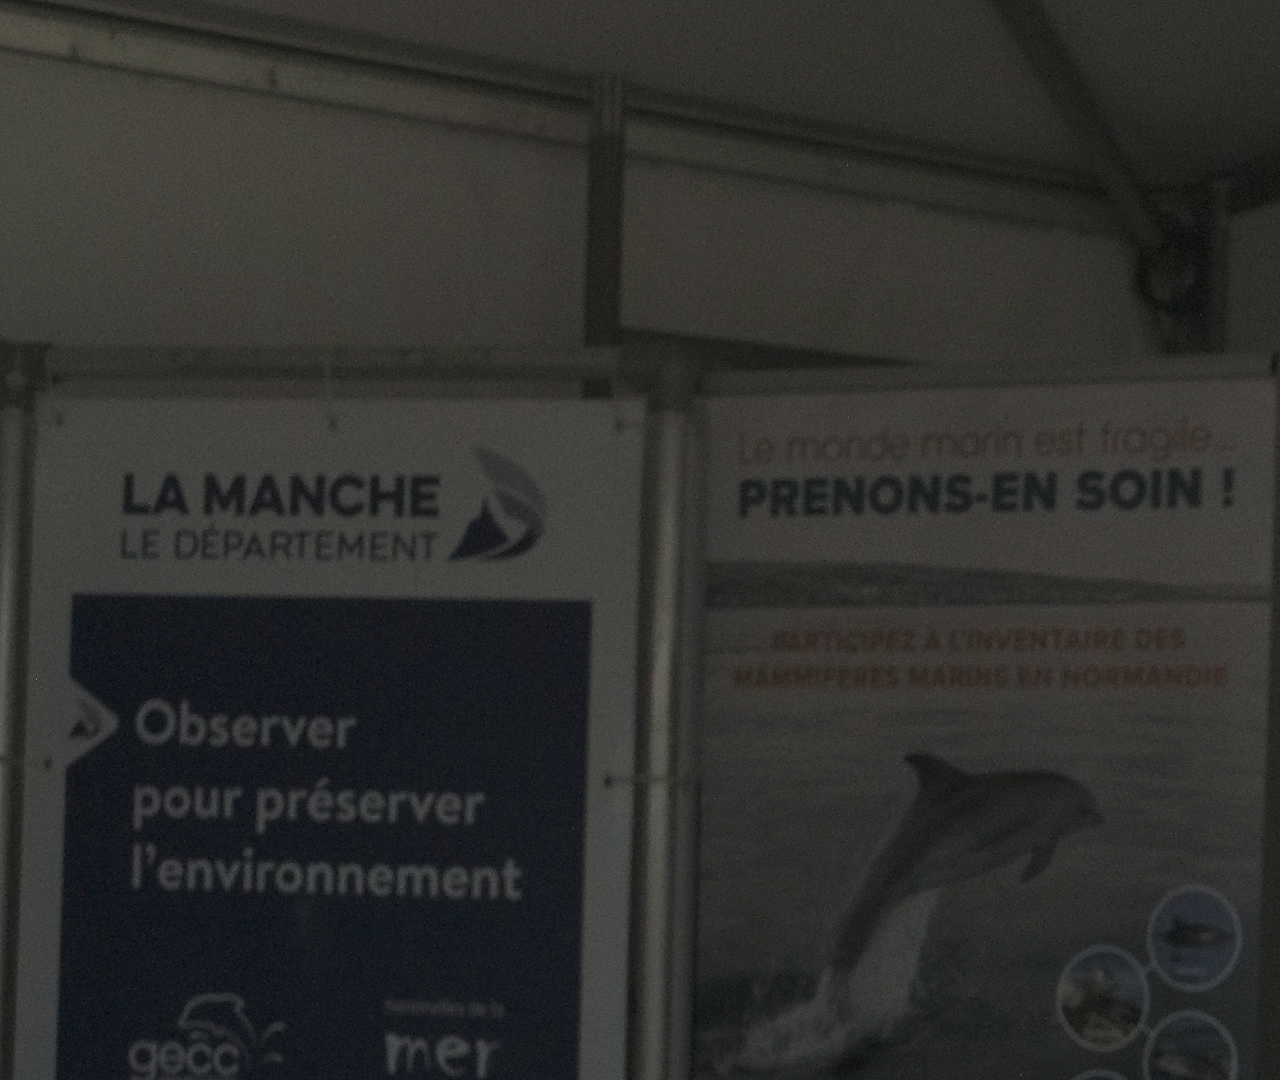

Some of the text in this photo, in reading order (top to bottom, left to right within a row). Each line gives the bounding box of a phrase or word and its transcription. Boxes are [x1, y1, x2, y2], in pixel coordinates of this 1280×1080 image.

[737, 430, 774, 465] Le
[786, 425, 909, 463] monde
[921, 422, 1022, 459] marin
[1034, 424, 1087, 458] est
[121, 474, 440, 518] LA MANCHE
[737, 466, 1235, 518] PRENONS-EN SOIN !
[119, 524, 438, 562] LE DÉPARTEMENT
[1133, 625, 1187, 650] DES
[908, 664, 1009, 689] MARINS
[1017, 664, 1053, 687] EN
[1061, 663, 1228, 688] NORMANDIE
[134, 698, 356, 749] Observer
[133, 777, 485, 834] pour préserver
[384, 1032, 501, 1080] mer
